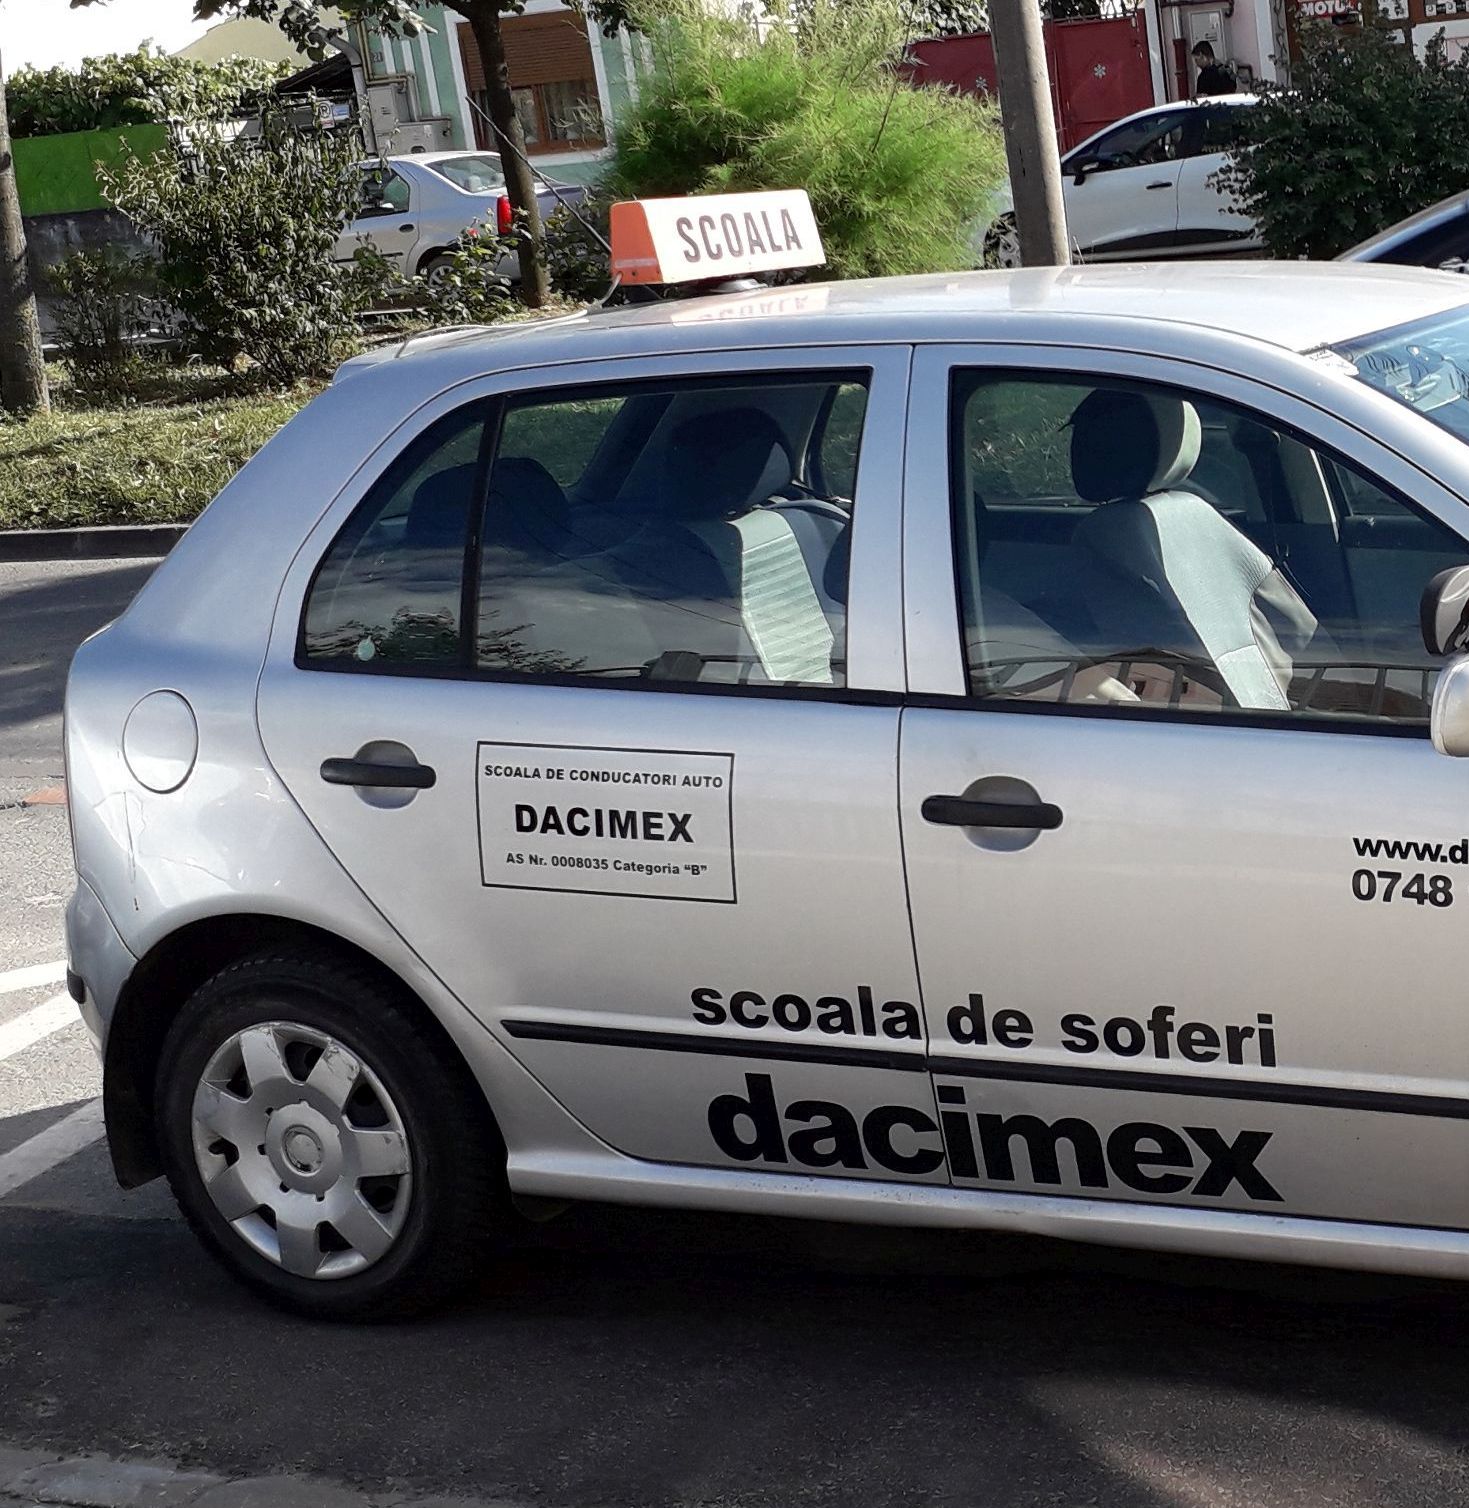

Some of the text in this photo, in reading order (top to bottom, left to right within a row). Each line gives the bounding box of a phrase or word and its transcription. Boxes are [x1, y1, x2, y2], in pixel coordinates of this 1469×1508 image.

[1301, 0, 1353, 16] MOTU
[675, 208, 804, 263] SCOALA
[484, 764, 723, 788] SCOALA DE CONDUCATORI AUTO
[514, 803, 695, 843] DACIMEX
[505, 852, 525, 865] AS
[528, 853, 548, 866] Nr.
[550, 855, 609, 871] 0008035
[612, 859, 680, 876] Categoria
[1351, 868, 1454, 908] 0748
[690, 985, 1277, 1068] scoala de soferi
[706, 1072, 1287, 1203] dacimex
